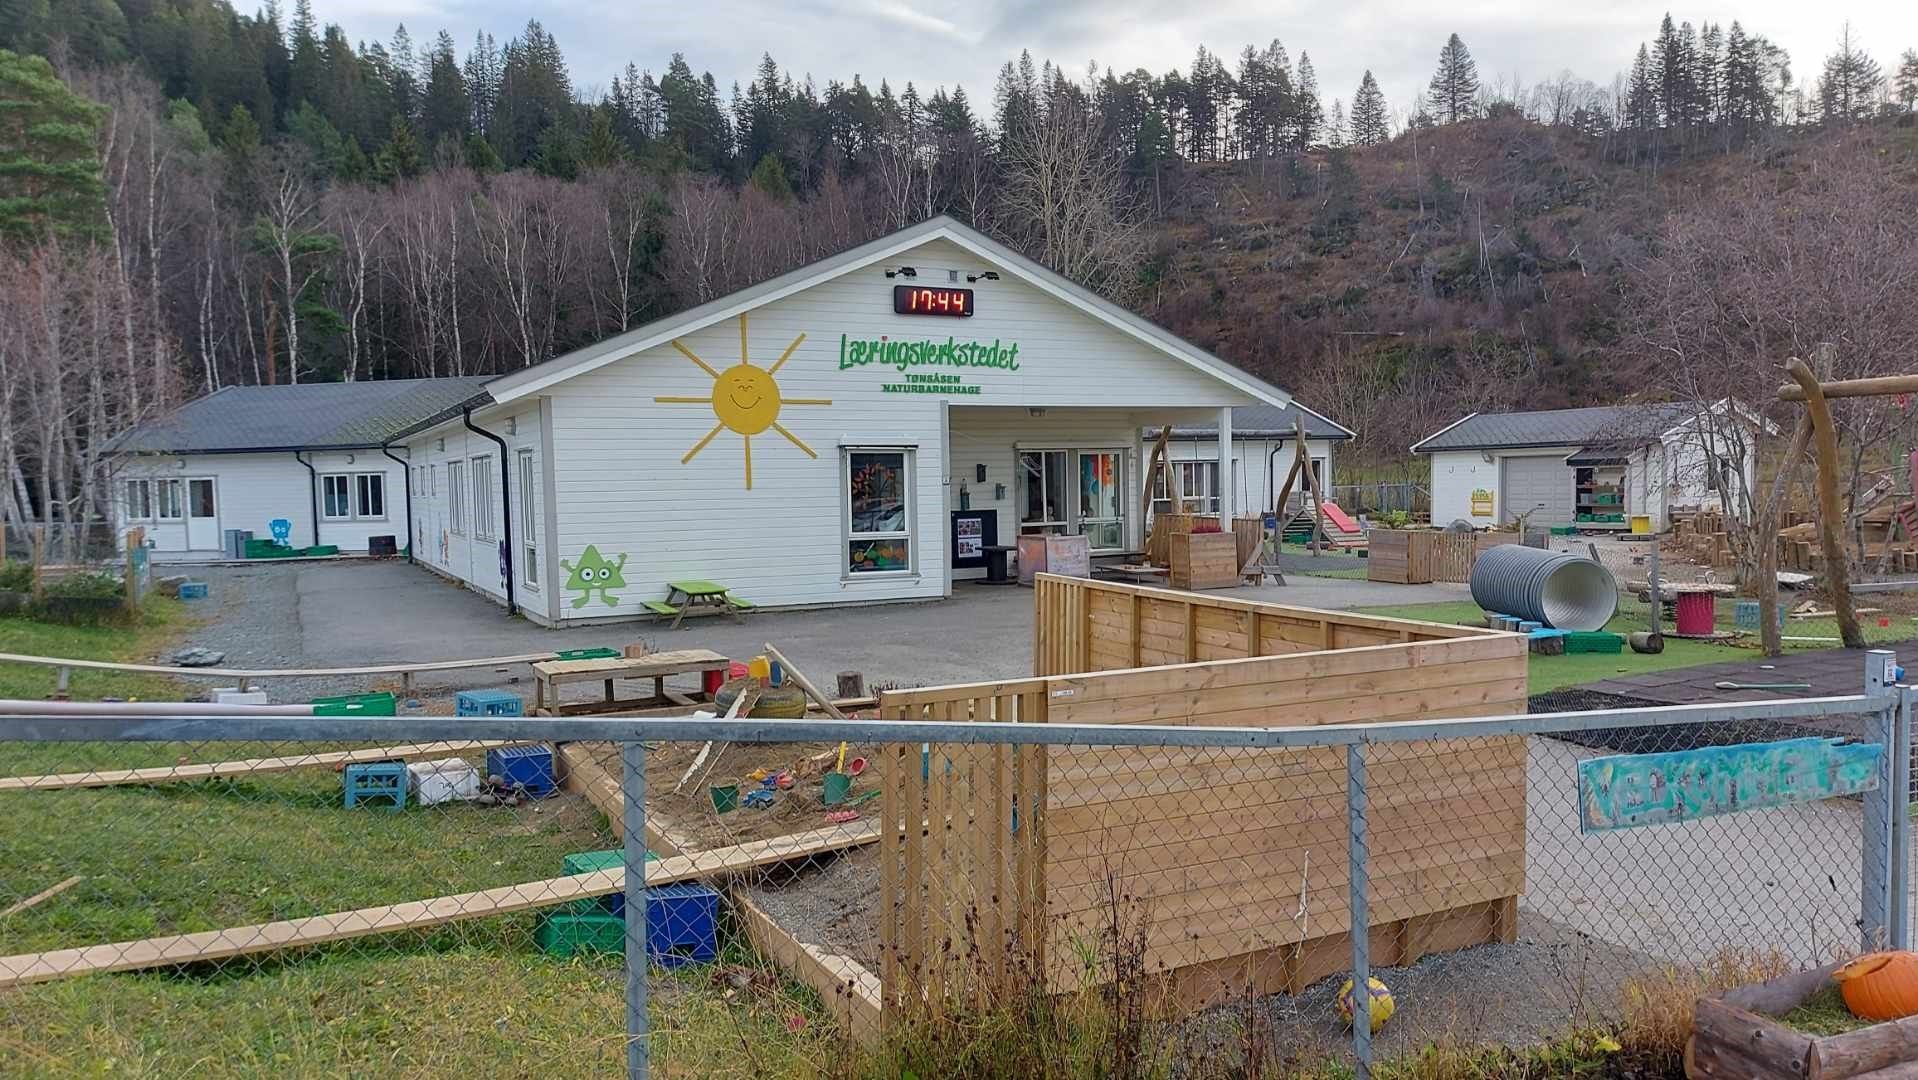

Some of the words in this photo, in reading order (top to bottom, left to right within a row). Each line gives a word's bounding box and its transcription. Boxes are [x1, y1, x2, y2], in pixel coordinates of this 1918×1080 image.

[912, 290, 964, 312] 17:44
[839, 333, 1020, 371] Læringsverkstedet
[905, 373, 961, 384] TØNSÅSEN
[881, 384, 981, 394] NATURBARNEHAGE
